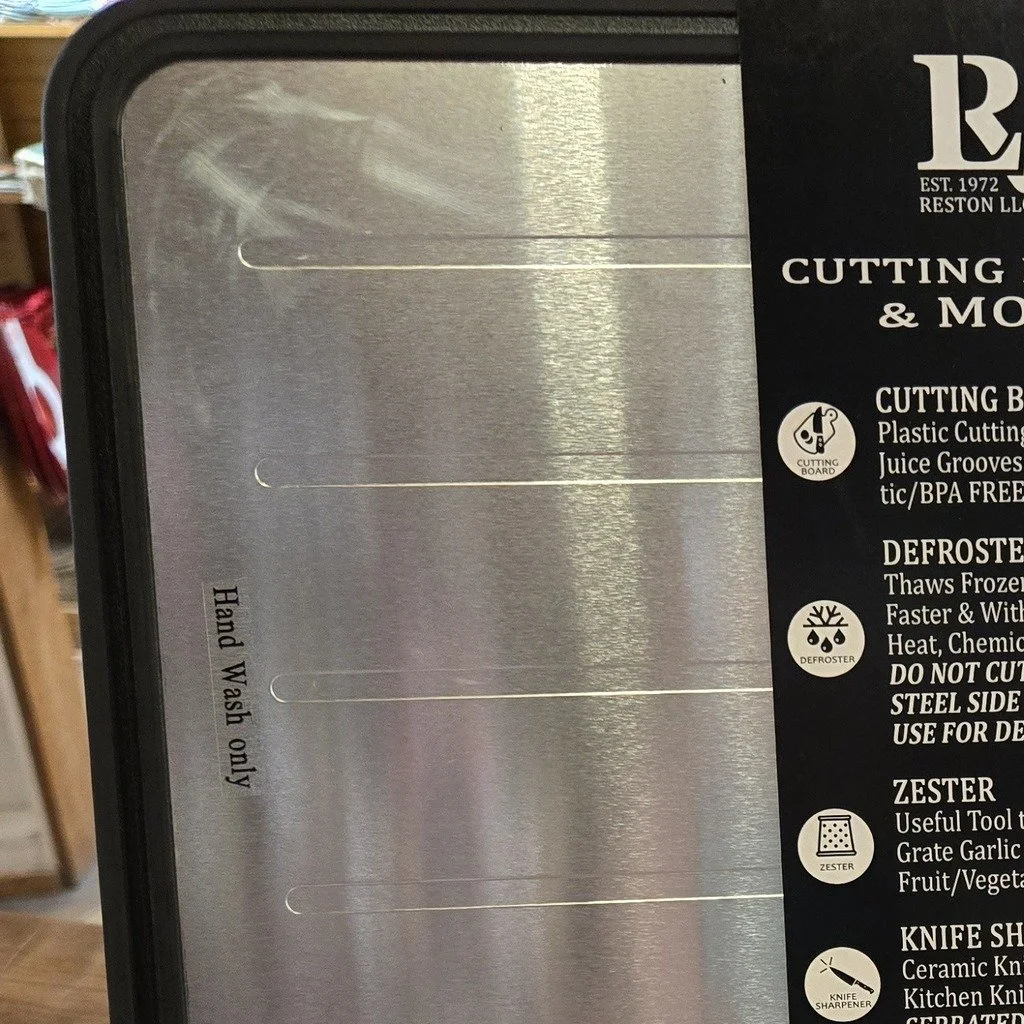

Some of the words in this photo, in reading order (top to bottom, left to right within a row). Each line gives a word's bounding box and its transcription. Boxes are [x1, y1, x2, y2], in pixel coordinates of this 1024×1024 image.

[919, 176, 953, 193] EST.
[958, 176, 999, 193] 1972
[919, 196, 994, 213] RESTON
[781, 257, 1005, 285] CUTTING
[878, 302, 919, 329] &
[875, 385, 999, 414] CUTTING
[877, 419, 949, 444] Plastic
[801, 467, 835, 475] BOARD
[878, 451, 931, 480] Juice
[880, 481, 964, 511] tic/BPA
[883, 572, 955, 596] Thaws
[213, 586, 244, 649] Hand
[885, 603, 953, 626] Faster
[887, 633, 943, 658] Heat,
[800, 655, 855, 664] DEFROSTER
[889, 662, 924, 686] DO
[929, 661, 981, 685] NOT
[221, 661, 252, 726] Wash
[890, 691, 962, 716] STEEL
[966, 690, 1021, 714] SIDE
[893, 722, 937, 745] USE
[941, 721, 989, 744] FOR
[225, 738, 257, 788] only
[892, 776, 997, 805] ZESTER
[895, 809, 962, 834] Useful
[966, 807, 1013, 832] Tool
[896, 841, 954, 864] Grate
[959, 837, 1021, 862] Garlic
[820, 862, 855, 871] ZESTER
[900, 923, 982, 952] KNIFE
[902, 956, 988, 980] Ceramic
[816, 1000, 872, 1010] SHARPENER
[903, 985, 984, 1010] Kitchen
